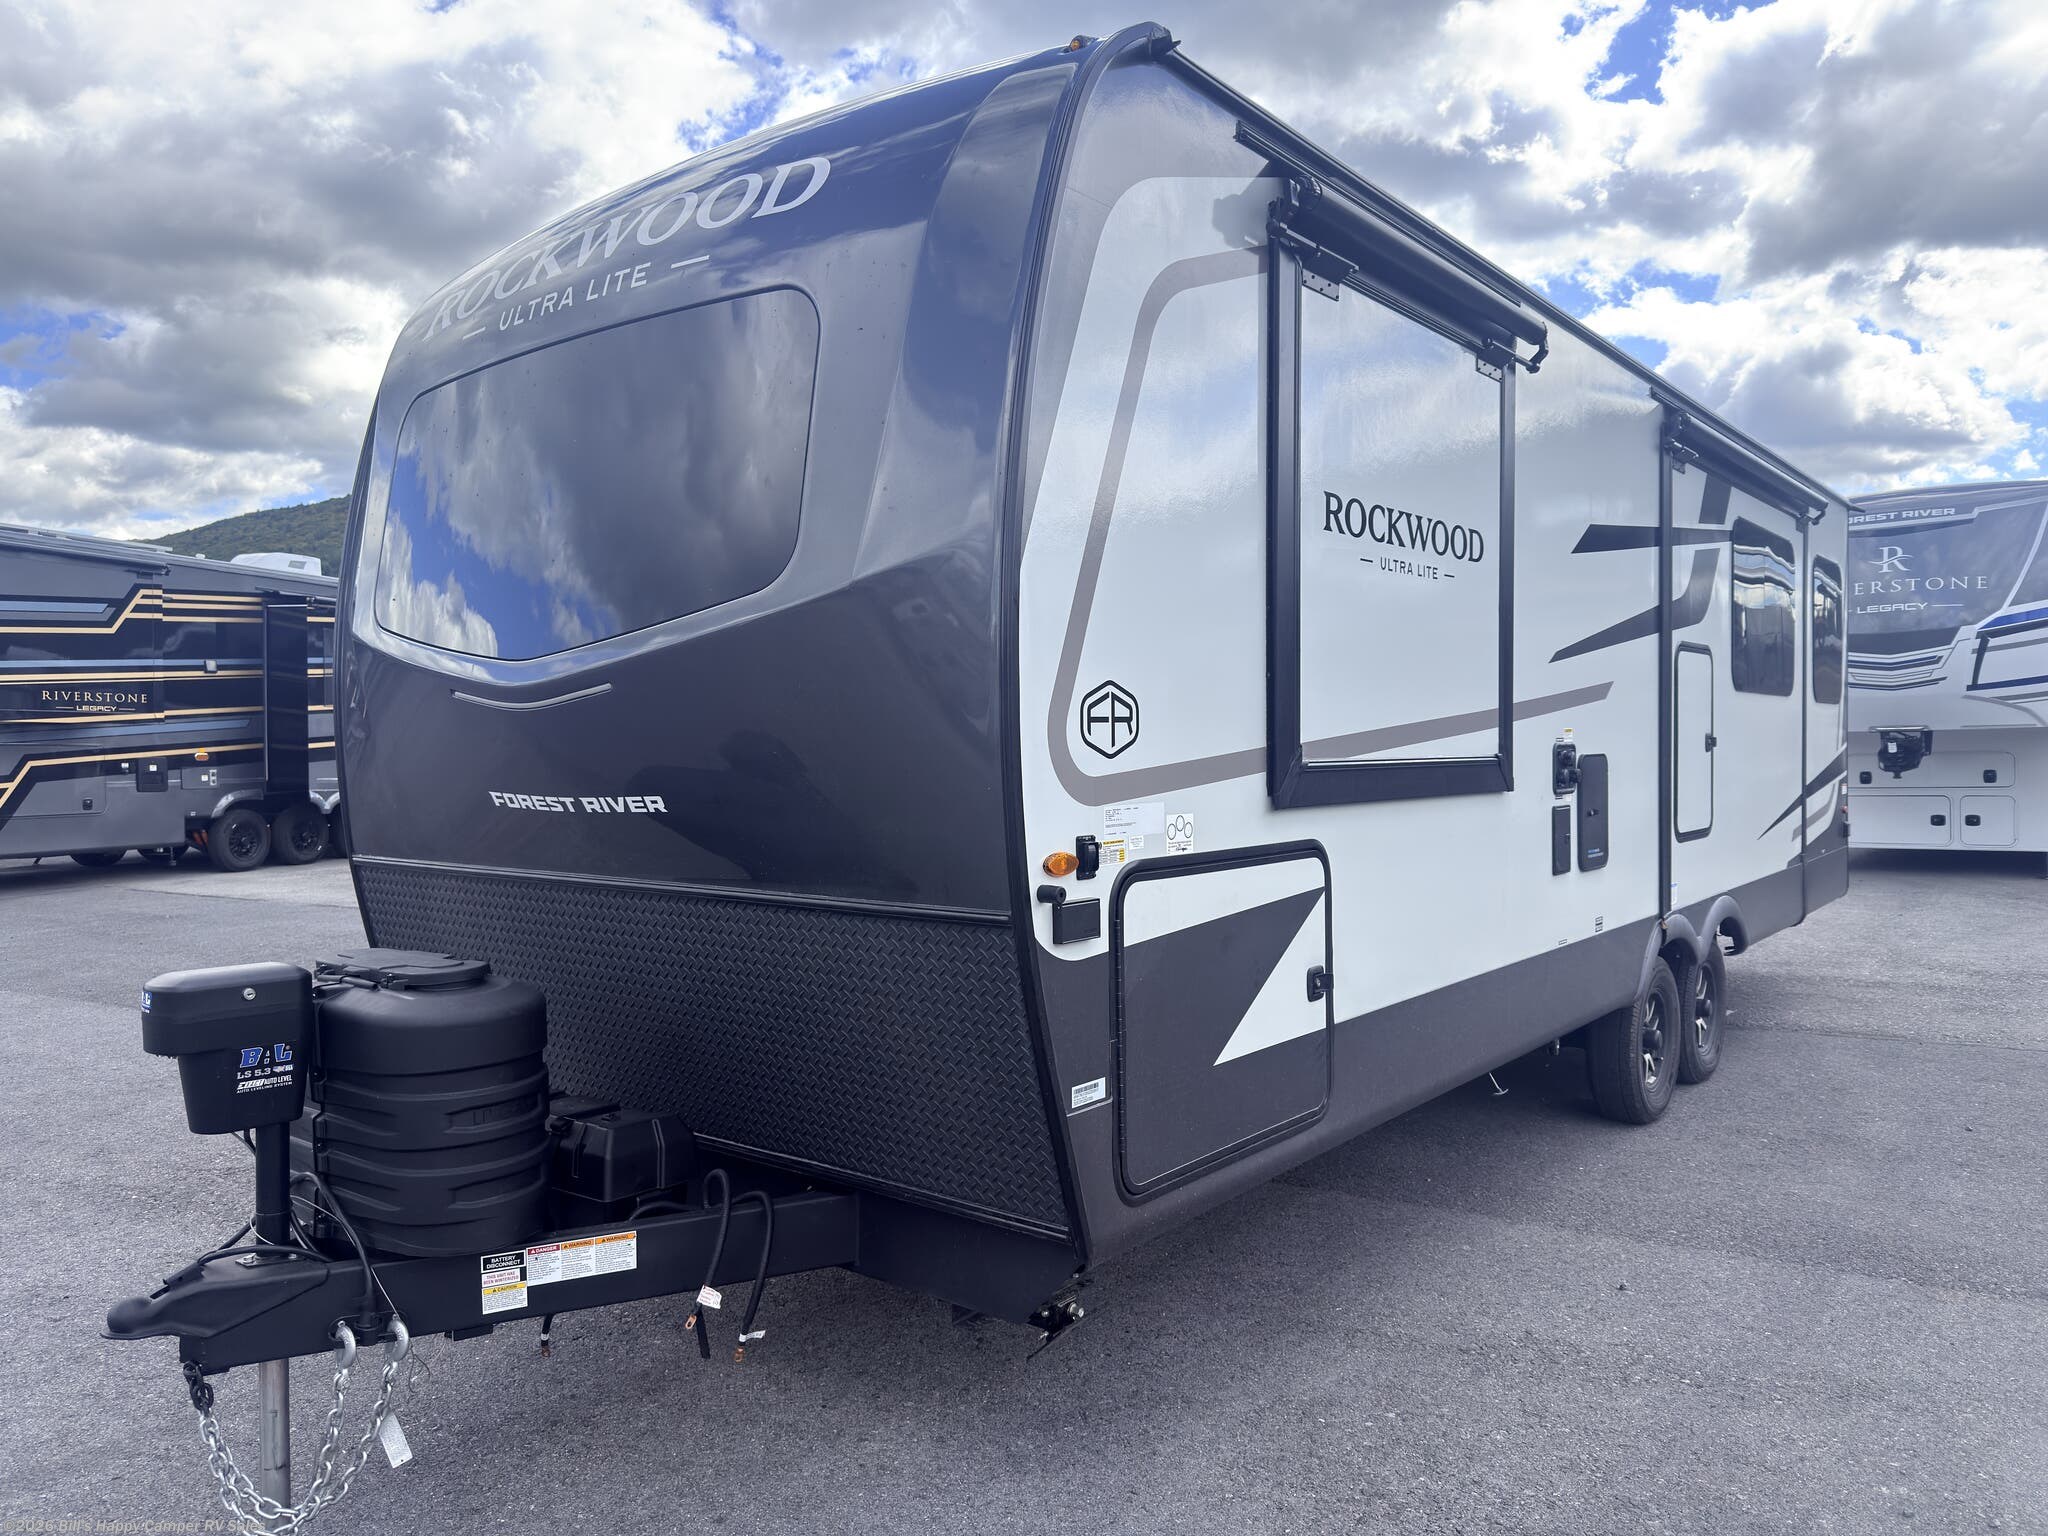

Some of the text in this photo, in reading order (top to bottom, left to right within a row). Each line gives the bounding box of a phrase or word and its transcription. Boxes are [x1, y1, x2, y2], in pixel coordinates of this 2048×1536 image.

[422, 157, 831, 341] ROCKWOOD
[499, 262, 651, 331] ULTRA LITE
[1902, 508, 1956, 518] RIVER
[1323, 490, 1484, 562] ROCKWOOD
[1380, 556, 1438, 580] ULTRA LITE
[1854, 576, 1989, 595] ERSTONE
[1857, 602, 1928, 614] LEGACY
[42, 690, 148, 704] RIVERSTONE
[488, 791, 668, 813] FOREST RIVER
[237, 1070, 252, 1080] LS
[254, 1067, 271, 1077] 5.3
[535, 1245, 558, 1253] DANGER
[486, 1260, 520, 1269] DISCONNECT
[491, 1255, 516, 1263] BATTERY
